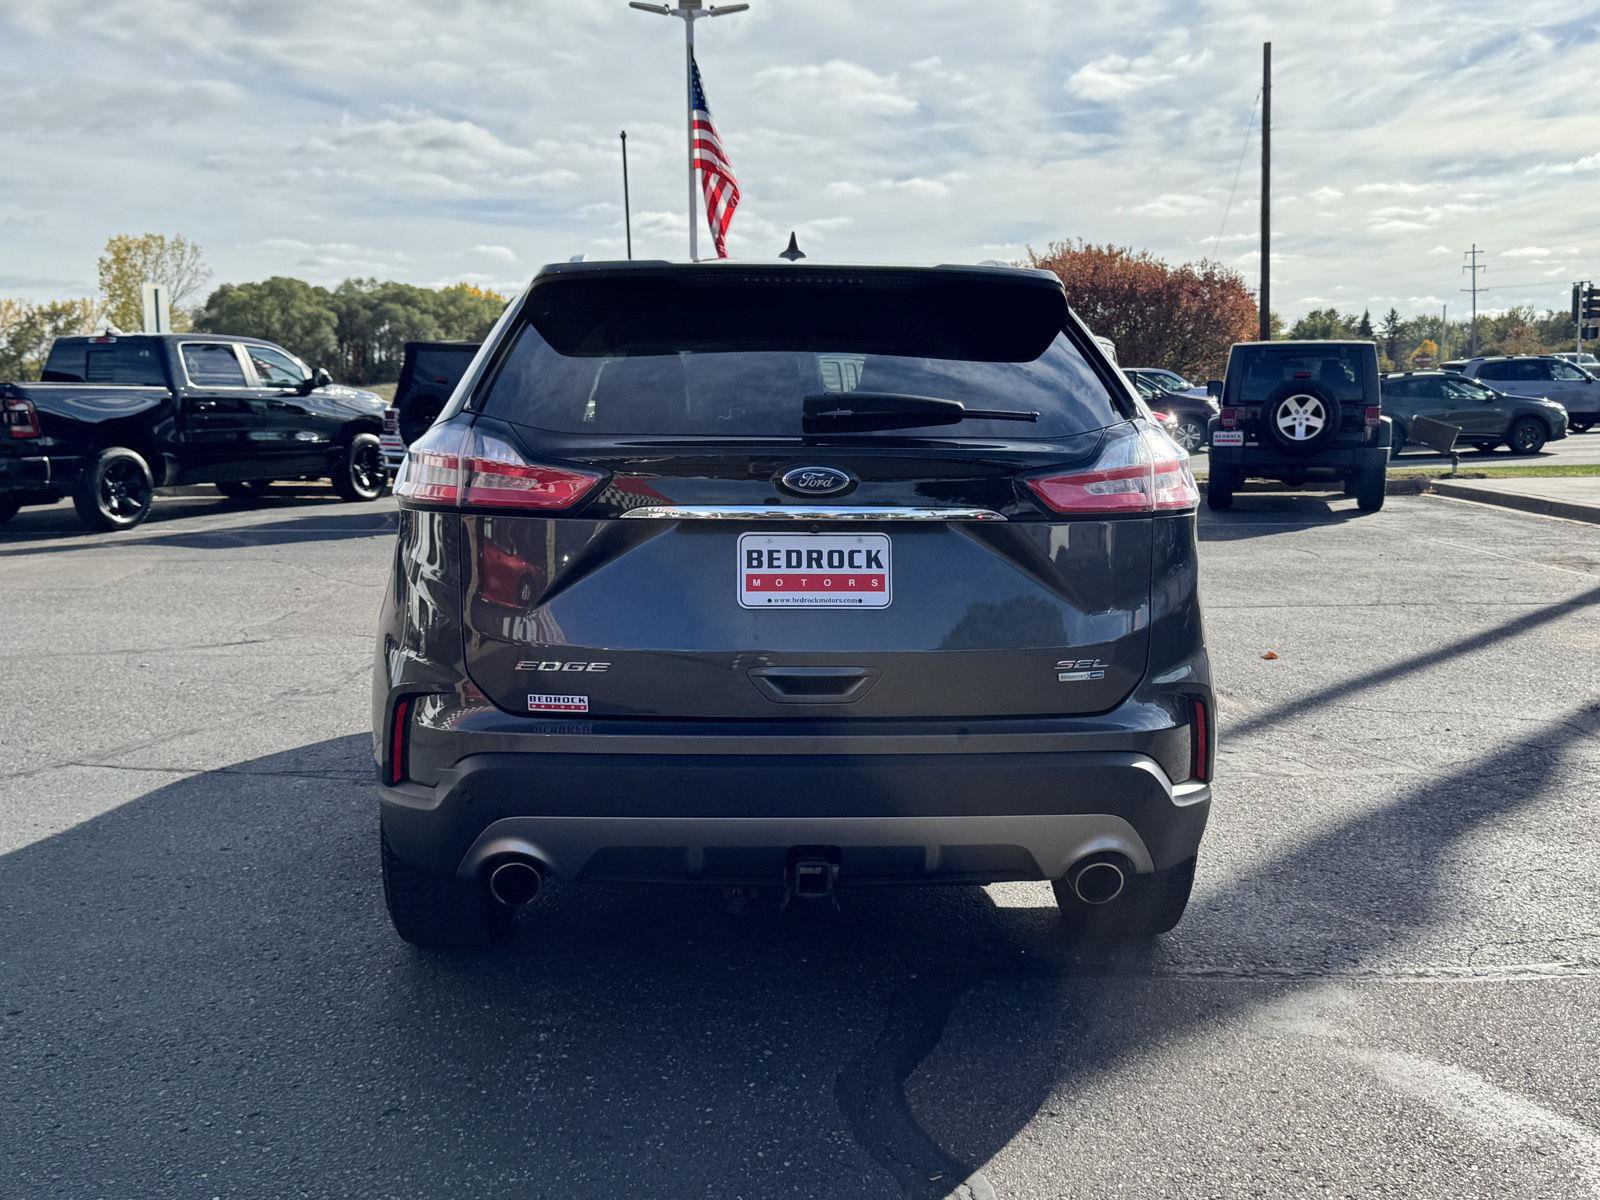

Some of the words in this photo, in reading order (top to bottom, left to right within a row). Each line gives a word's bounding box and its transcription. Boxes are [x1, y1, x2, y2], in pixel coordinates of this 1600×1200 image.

[799, 472, 834, 487] Ford
[746, 549, 883, 569] BEDROCK
[752, 578, 879, 587] MOTORS
[514, 661, 611, 672] EDGE
[1054, 659, 1109, 669] SEL
[529, 695, 586, 704] BEDROCK
